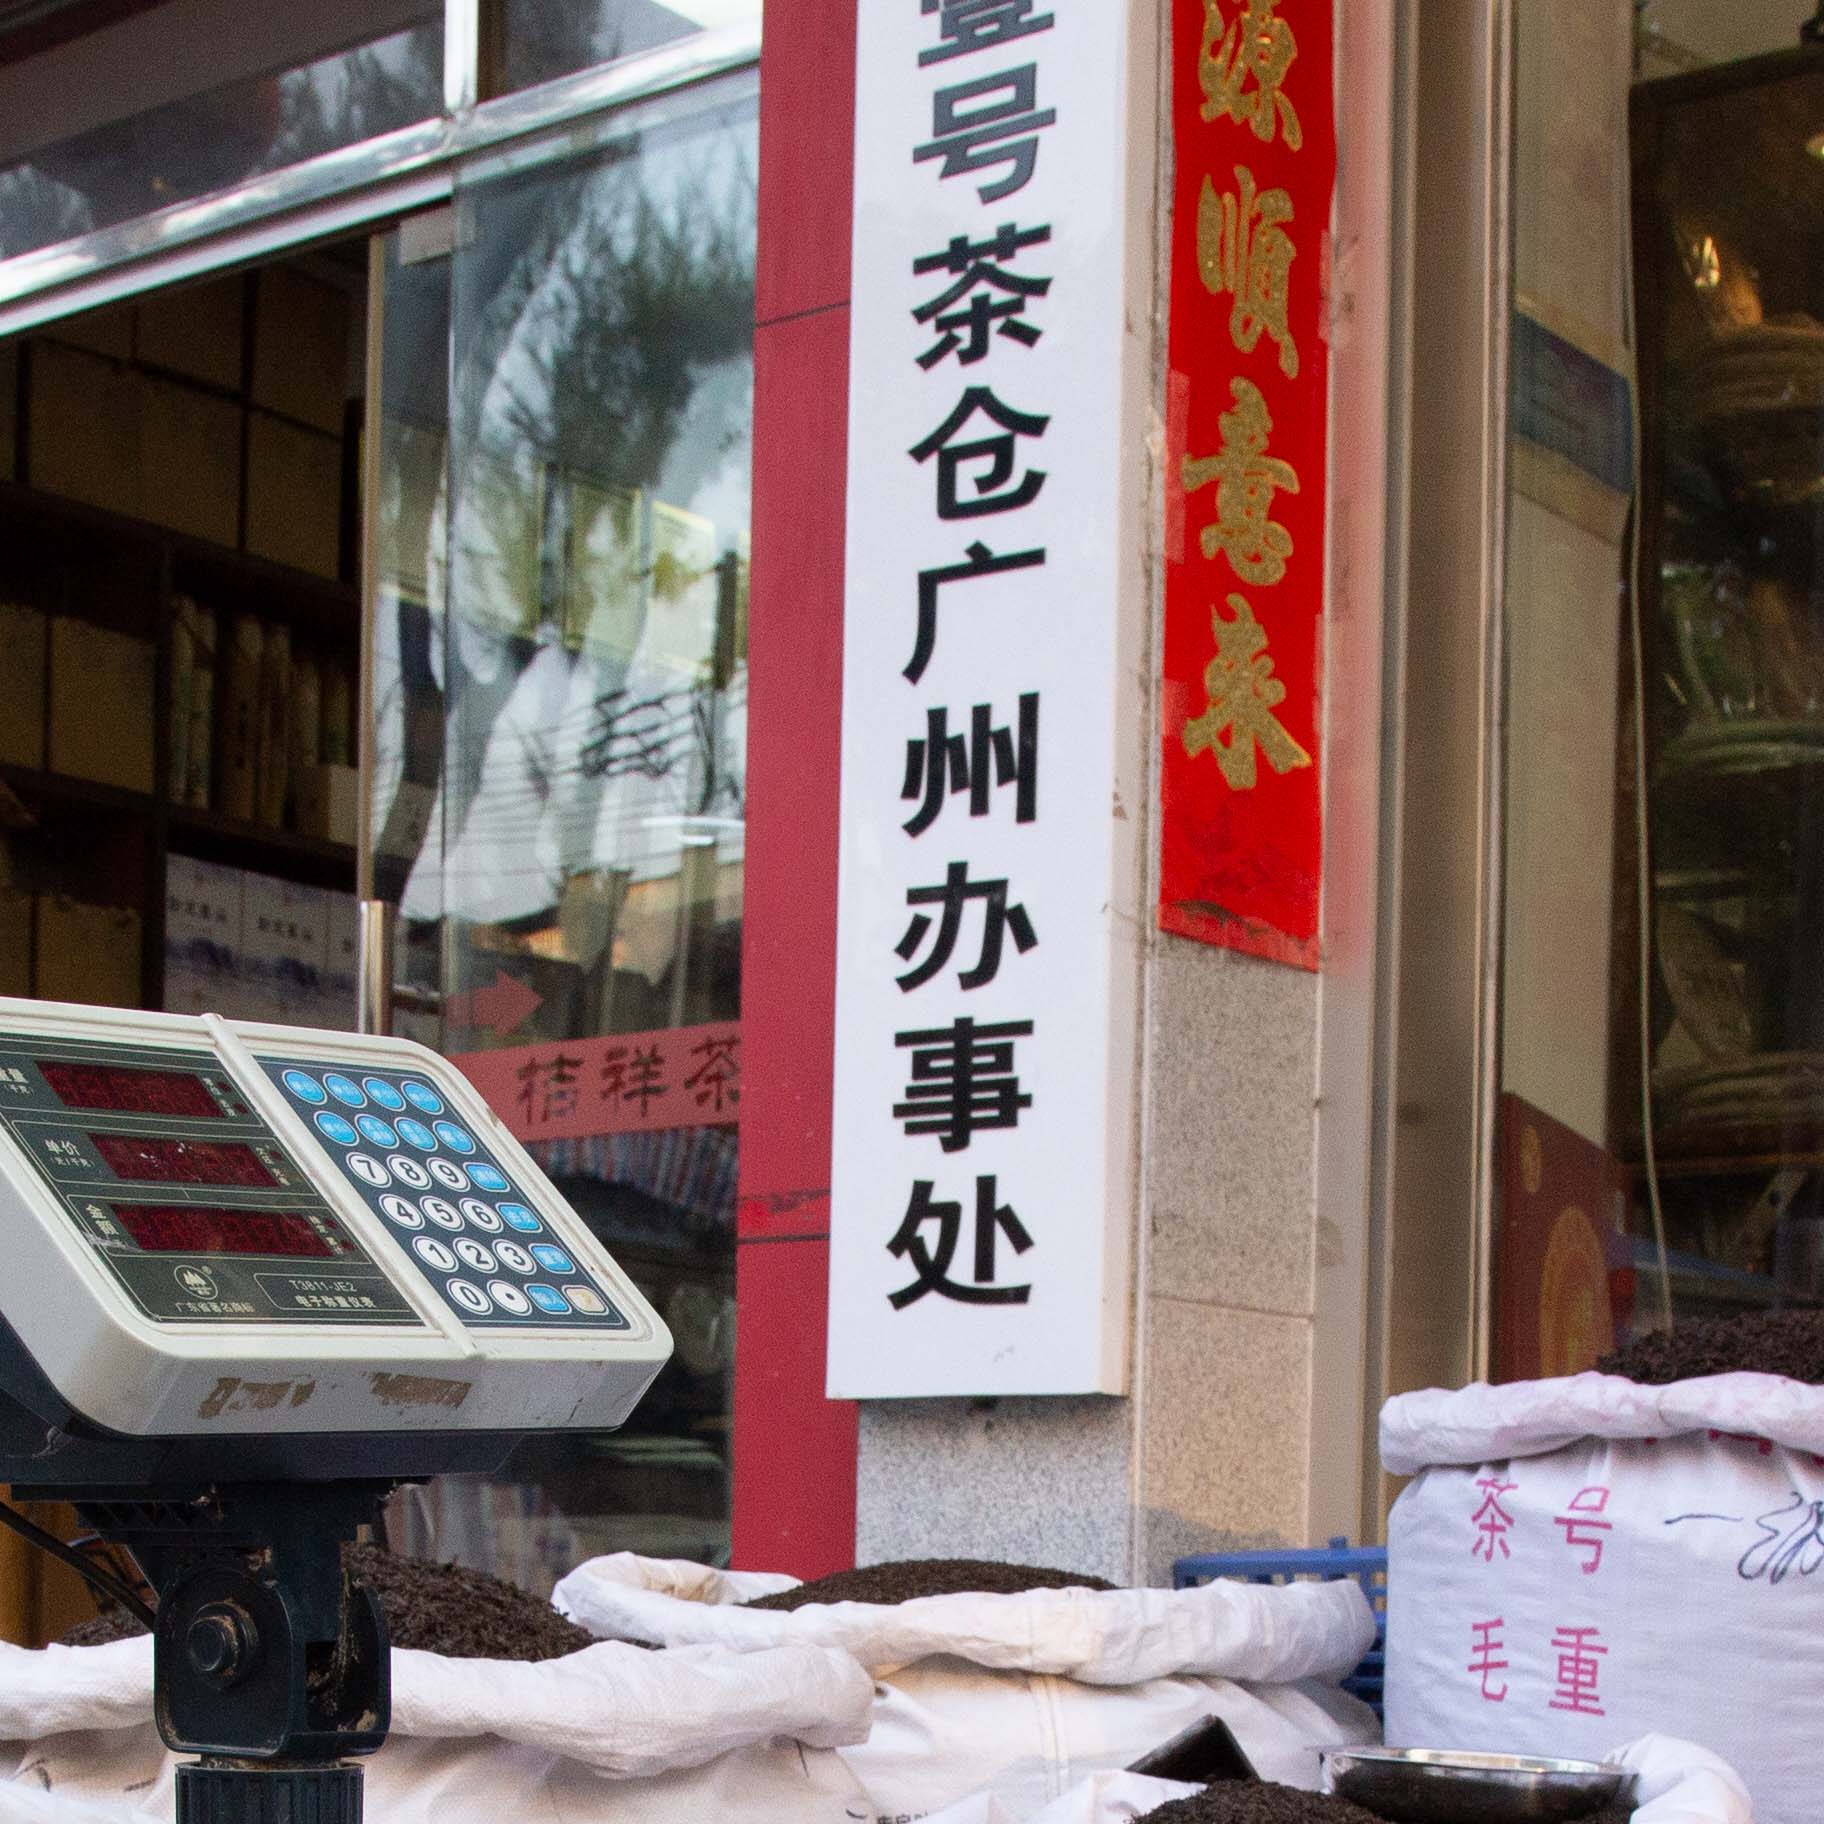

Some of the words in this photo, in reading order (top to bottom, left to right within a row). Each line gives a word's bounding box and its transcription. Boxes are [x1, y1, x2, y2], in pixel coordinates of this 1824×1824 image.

[45, 1138, 82, 1157] 单价
[357, 1160, 377, 1180] 7
[399, 1161, 421, 1182] 8
[439, 1164, 459, 1184] 9
[85, 1203, 118, 1236] 金额
[395, 1201, 414, 1222] 4
[433, 1203, 453, 1223] 5
[474, 1205, 492, 1225] 6
[428, 1243, 447, 1264] 1
[465, 1245, 490, 1265] 2
[504, 1246, 525, 1267] 3
[460, 1286, 481, 1306] 0
[1471, 1478, 1614, 1576] 茶号
[1467, 1617, 1609, 1718] 毛重
